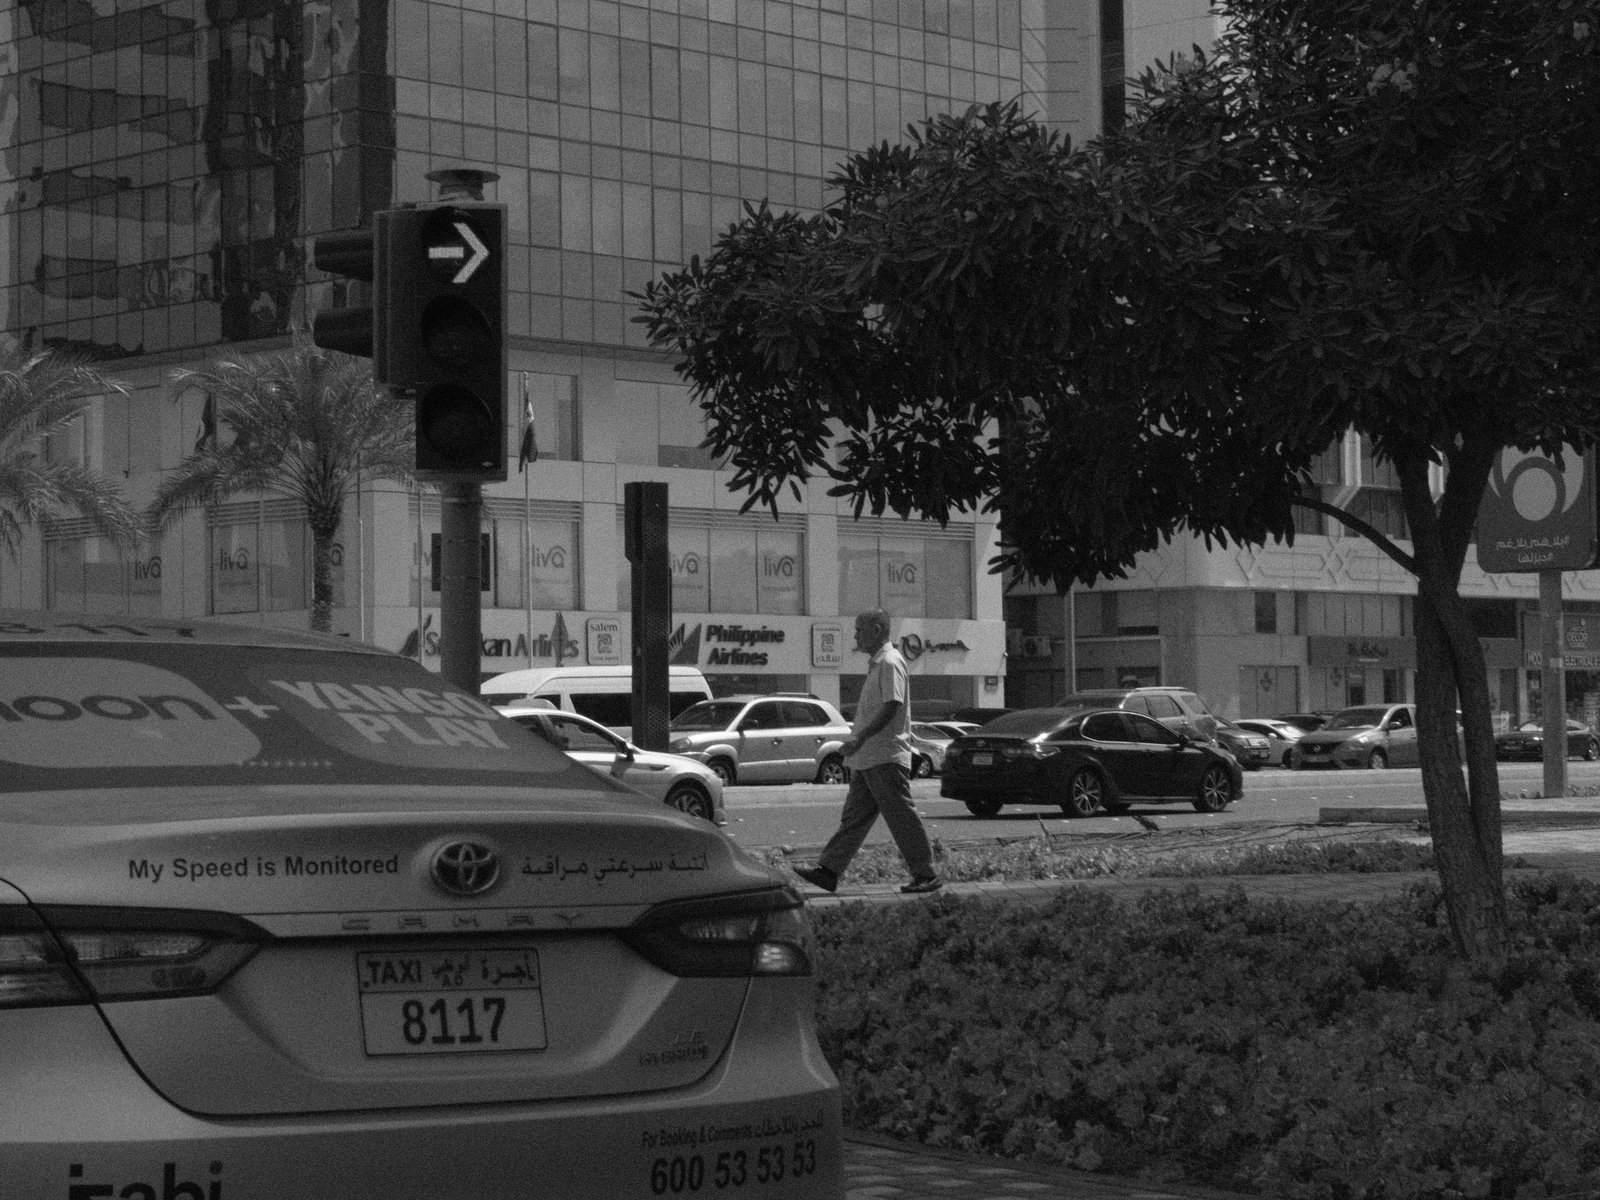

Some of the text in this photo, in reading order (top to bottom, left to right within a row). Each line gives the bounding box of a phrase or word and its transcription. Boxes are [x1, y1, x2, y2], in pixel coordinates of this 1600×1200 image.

[135, 556, 162, 580] liva
[220, 547, 249, 571] liva
[532, 544, 567, 568] liva
[672, 551, 701, 575] iva
[764, 555, 796, 578] liva
[887, 562, 917, 584] liva
[706, 624, 785, 647] Philippine
[707, 647, 769, 666] Airlines
[0, 695, 218, 722] oon
[267, 680, 500, 720] YANGO
[339, 712, 510, 749] PLAY
[128, 854, 399, 883] My Speed is Monitored
[366, 959, 422, 984] TAXI
[402, 997, 506, 1045] 8117
[650, 1139, 817, 1195] 600 53 53 53
